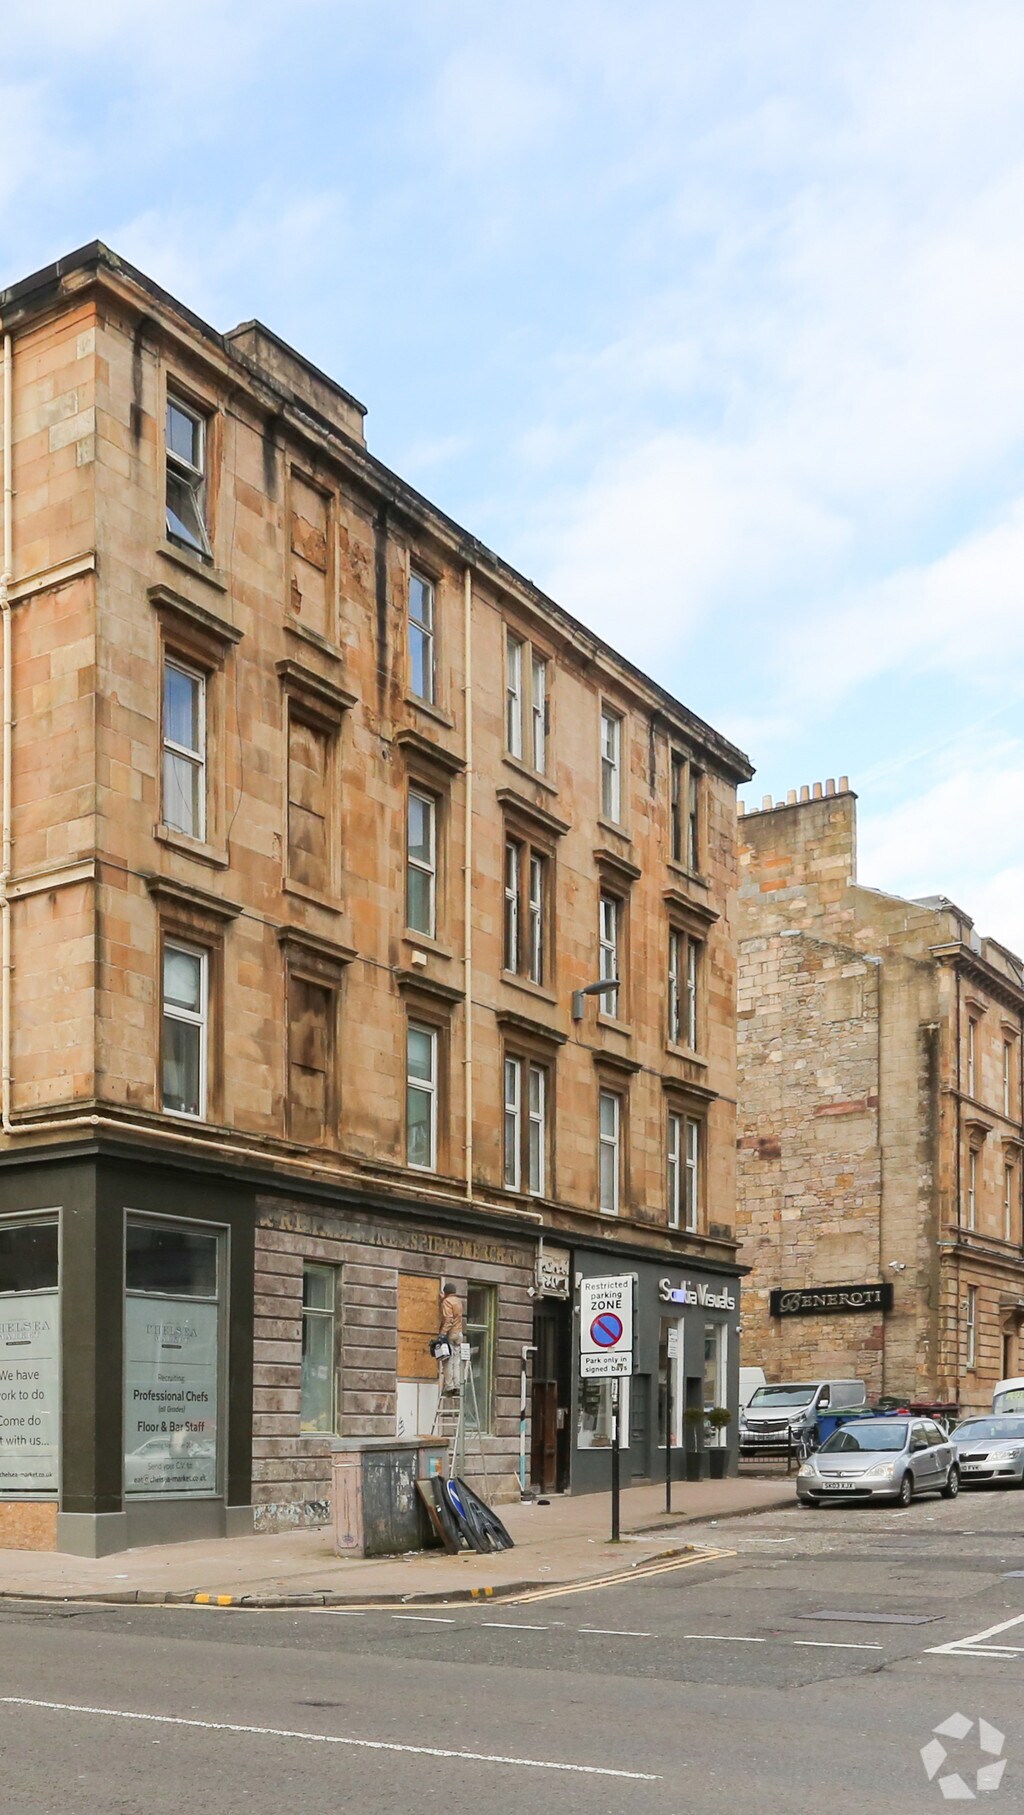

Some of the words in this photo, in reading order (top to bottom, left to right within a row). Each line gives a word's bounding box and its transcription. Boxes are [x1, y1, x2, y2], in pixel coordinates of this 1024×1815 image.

[585, 1281, 628, 1290] Restricted
[591, 1292, 622, 1300] parking
[696, 1284, 735, 1310] Visuals
[591, 1300, 622, 1310] ZONE
[603, 1357, 618, 1365] only
[585, 1365, 608, 1373] signed
[611, 1364, 628, 1373] bays
[16, 1369, 39, 1380] have
[19, 1390, 29, 1400] to
[31, 1389, 44, 1400] do
[133, 1390, 184, 1401] Professional
[186, 1391, 208, 1402] Chefs
[27, 1415, 41, 1426] do
[137, 1421, 159, 1432] Floor
[161, 1421, 167, 1432] &
[169, 1421, 183, 1432] Bar
[185, 1421, 205, 1432] Staff
[6, 1435, 27, 1446] with
